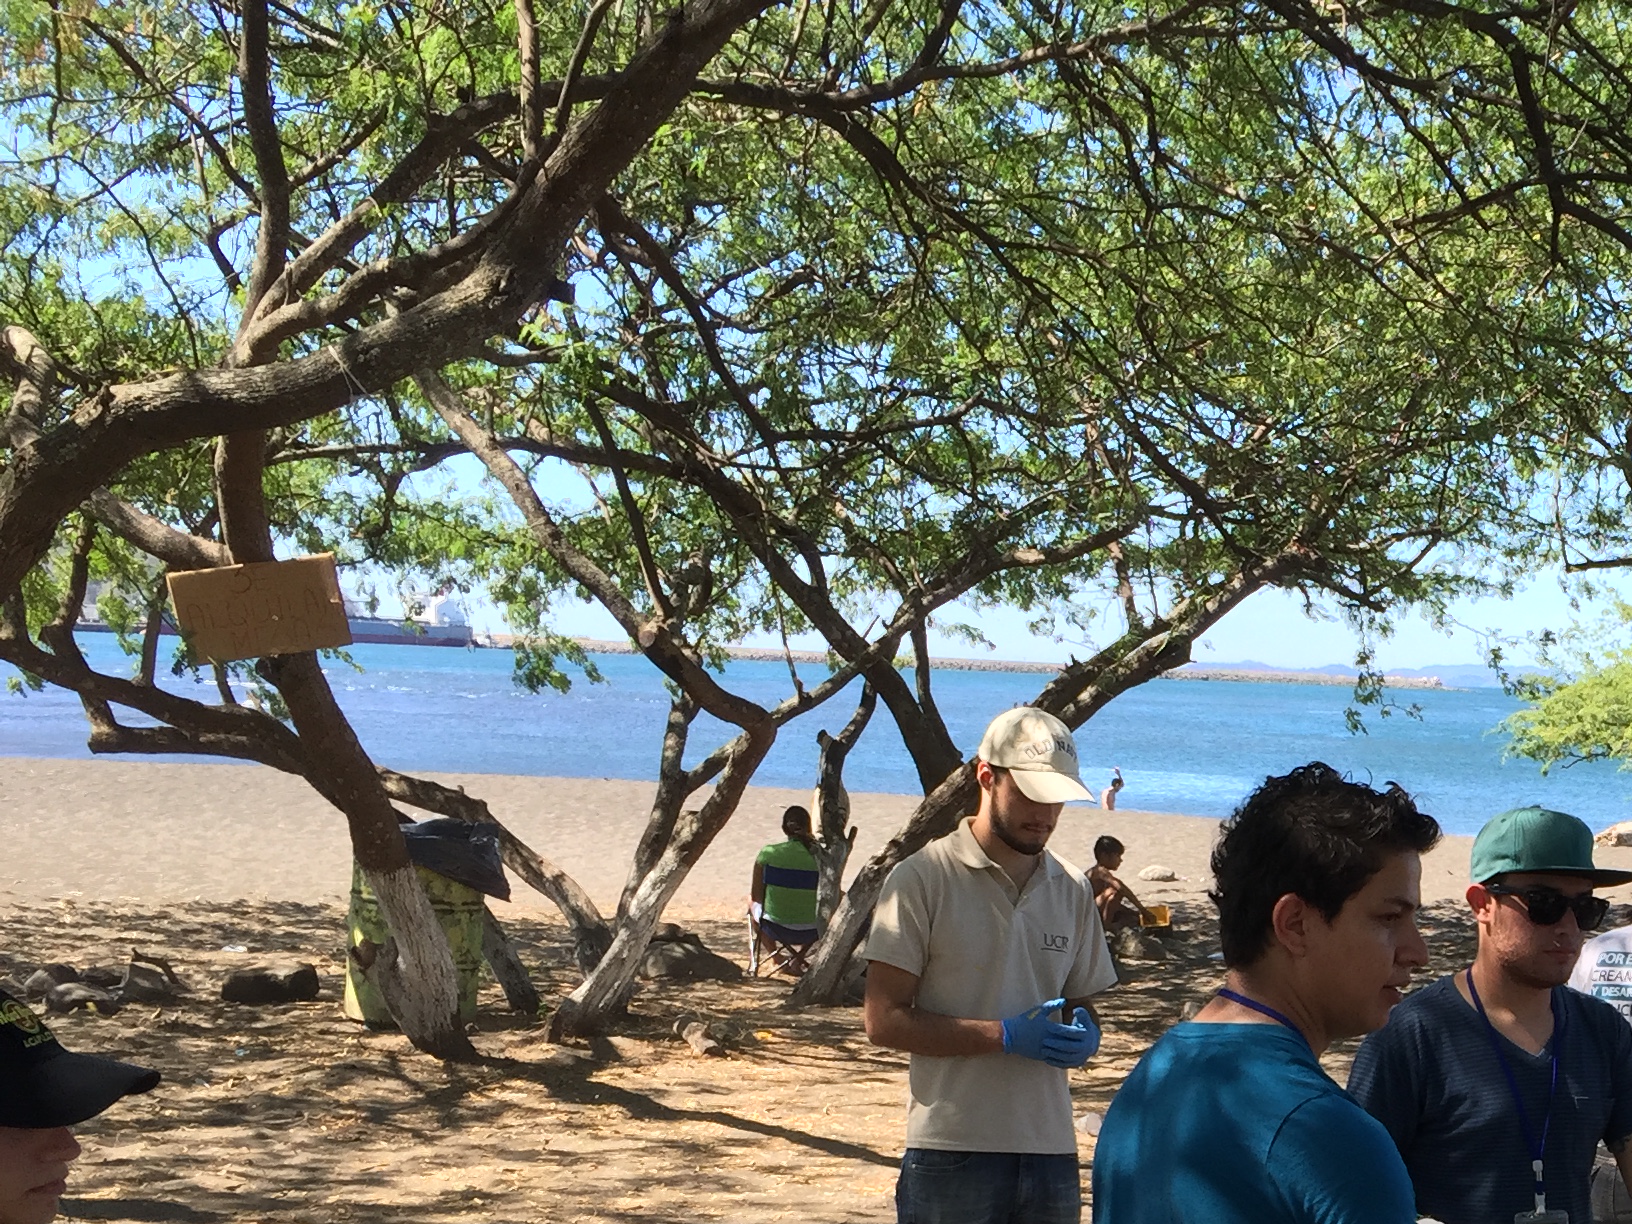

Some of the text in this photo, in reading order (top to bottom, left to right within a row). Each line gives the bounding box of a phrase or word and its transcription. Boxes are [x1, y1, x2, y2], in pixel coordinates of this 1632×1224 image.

[1024, 739, 1053, 759] OLD
[1044, 933, 1069, 949] UCR
[1599, 952, 1624, 965] POR
